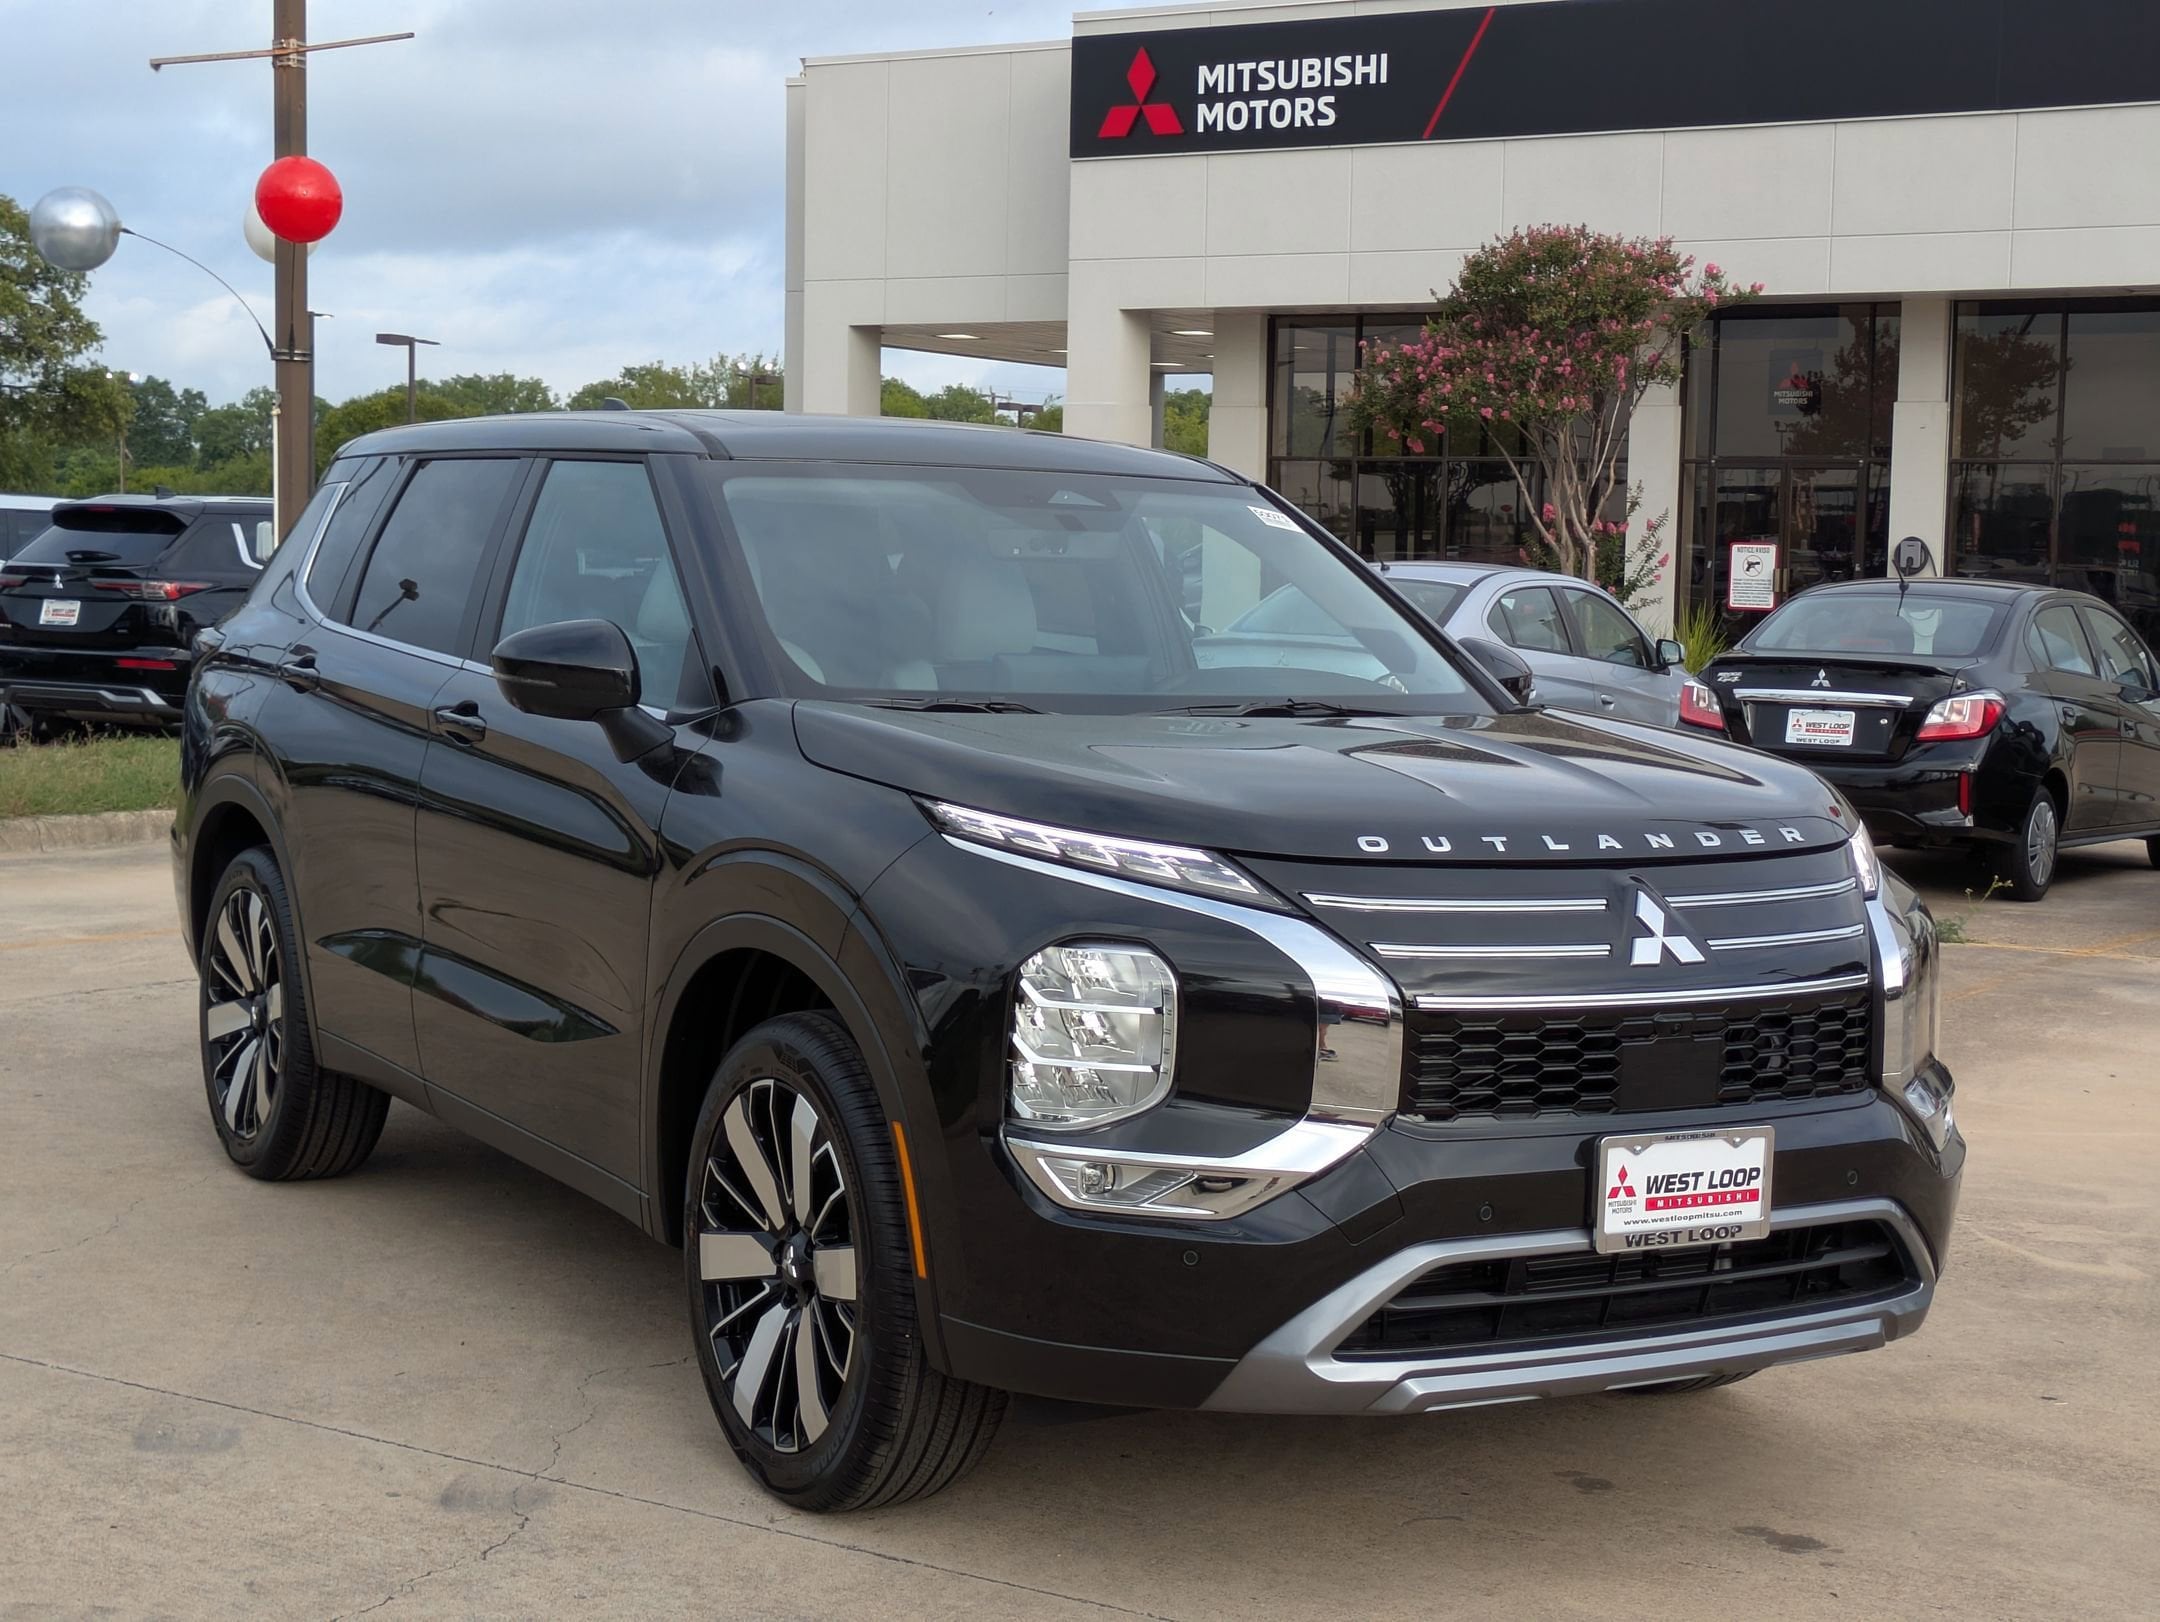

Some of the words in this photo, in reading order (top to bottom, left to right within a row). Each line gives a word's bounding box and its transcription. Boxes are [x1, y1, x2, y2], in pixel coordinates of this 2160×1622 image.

[1197, 53, 1388, 95] MITSUBISHI
[1197, 95, 1337, 133] MOTORS
[1805, 721, 1828, 729] WEST
[1828, 722, 1851, 730] LOOP
[1356, 826, 1806, 853] OUTLANDER
[1645, 1171, 1704, 1195] WEST
[1707, 1167, 1761, 1190] LOOP
[1608, 1199, 1637, 1207] MITSUBISHI
[1656, 1191, 1751, 1208] MITSUBISHI
[1611, 1207, 1633, 1215] MOTORS
[1623, 1209, 1743, 1226] www.westloopmitsu.com
[1624, 1230, 1683, 1248] WEST
[1687, 1224, 1743, 1242] LOOP
